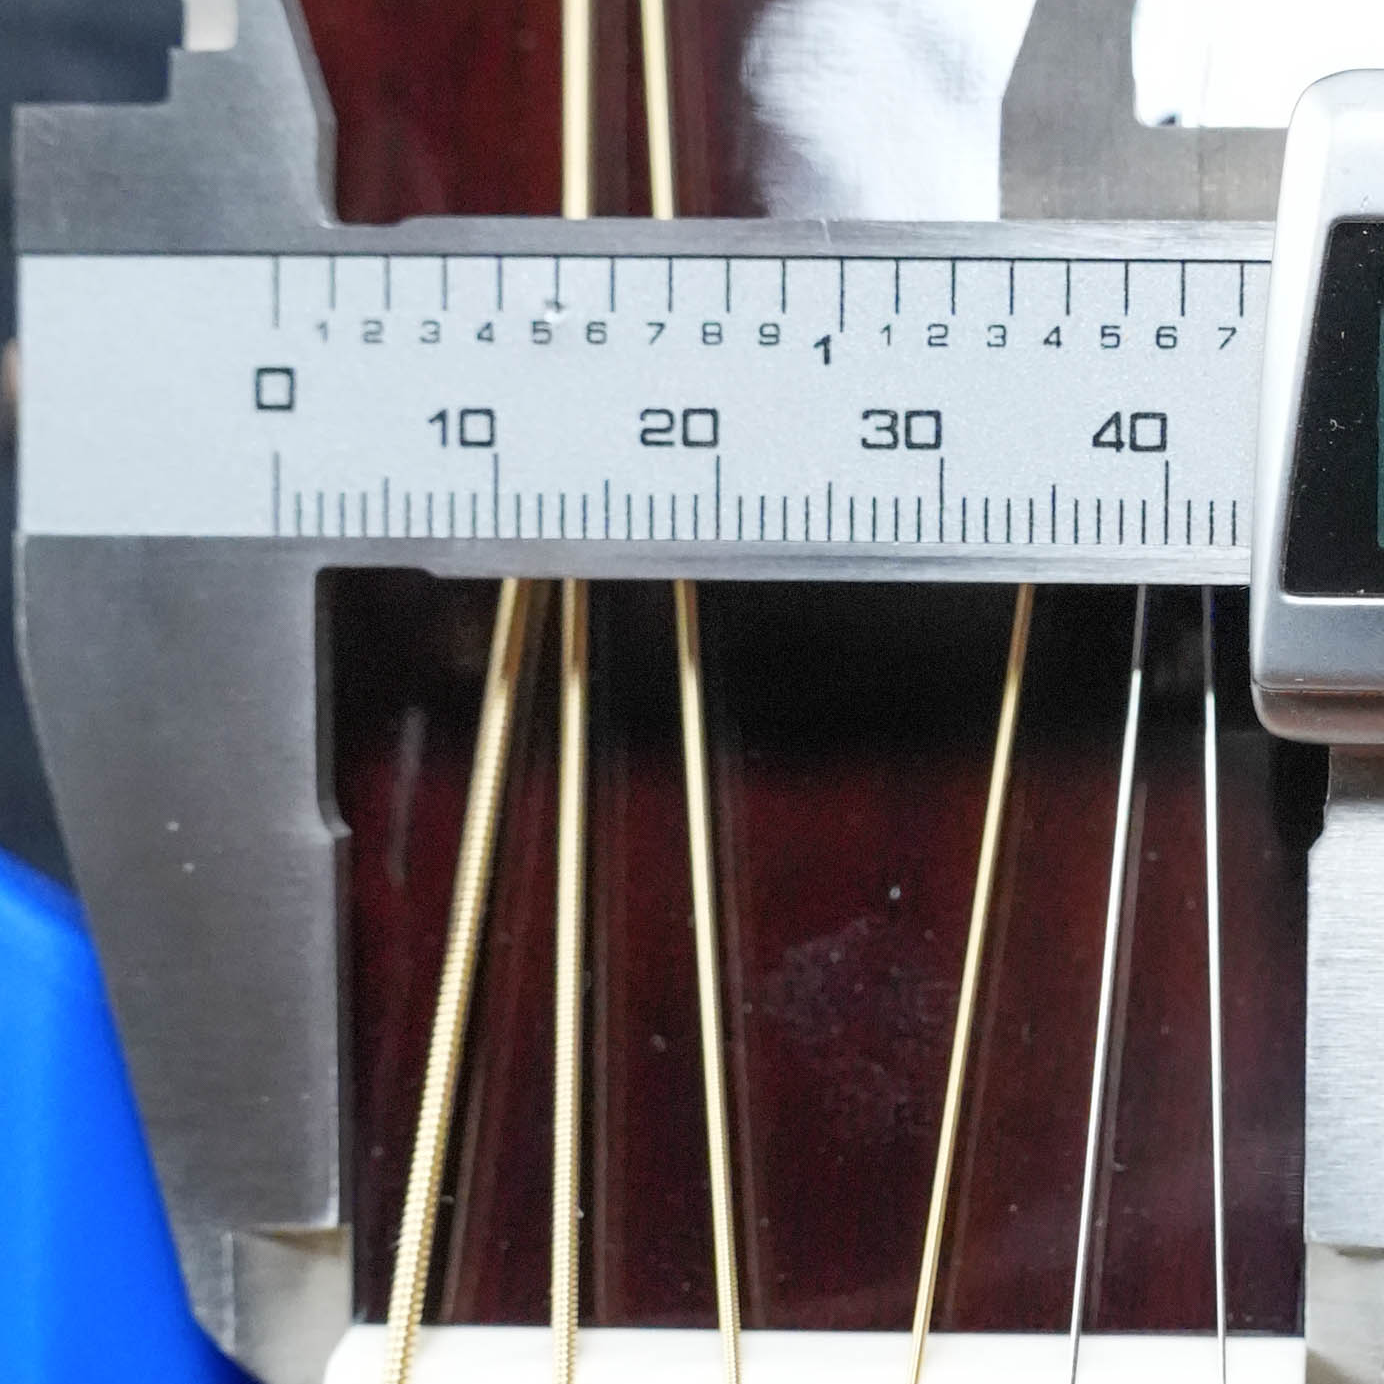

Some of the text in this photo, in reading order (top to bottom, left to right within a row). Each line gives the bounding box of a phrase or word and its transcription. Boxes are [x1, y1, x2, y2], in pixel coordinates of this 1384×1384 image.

[314, 319, 1238, 367] 1 2 3 4 5 6 7 8 9 1 1 2 3 4 5 6 7
[254, 366, 1168, 453] 0 10 20 30 40
